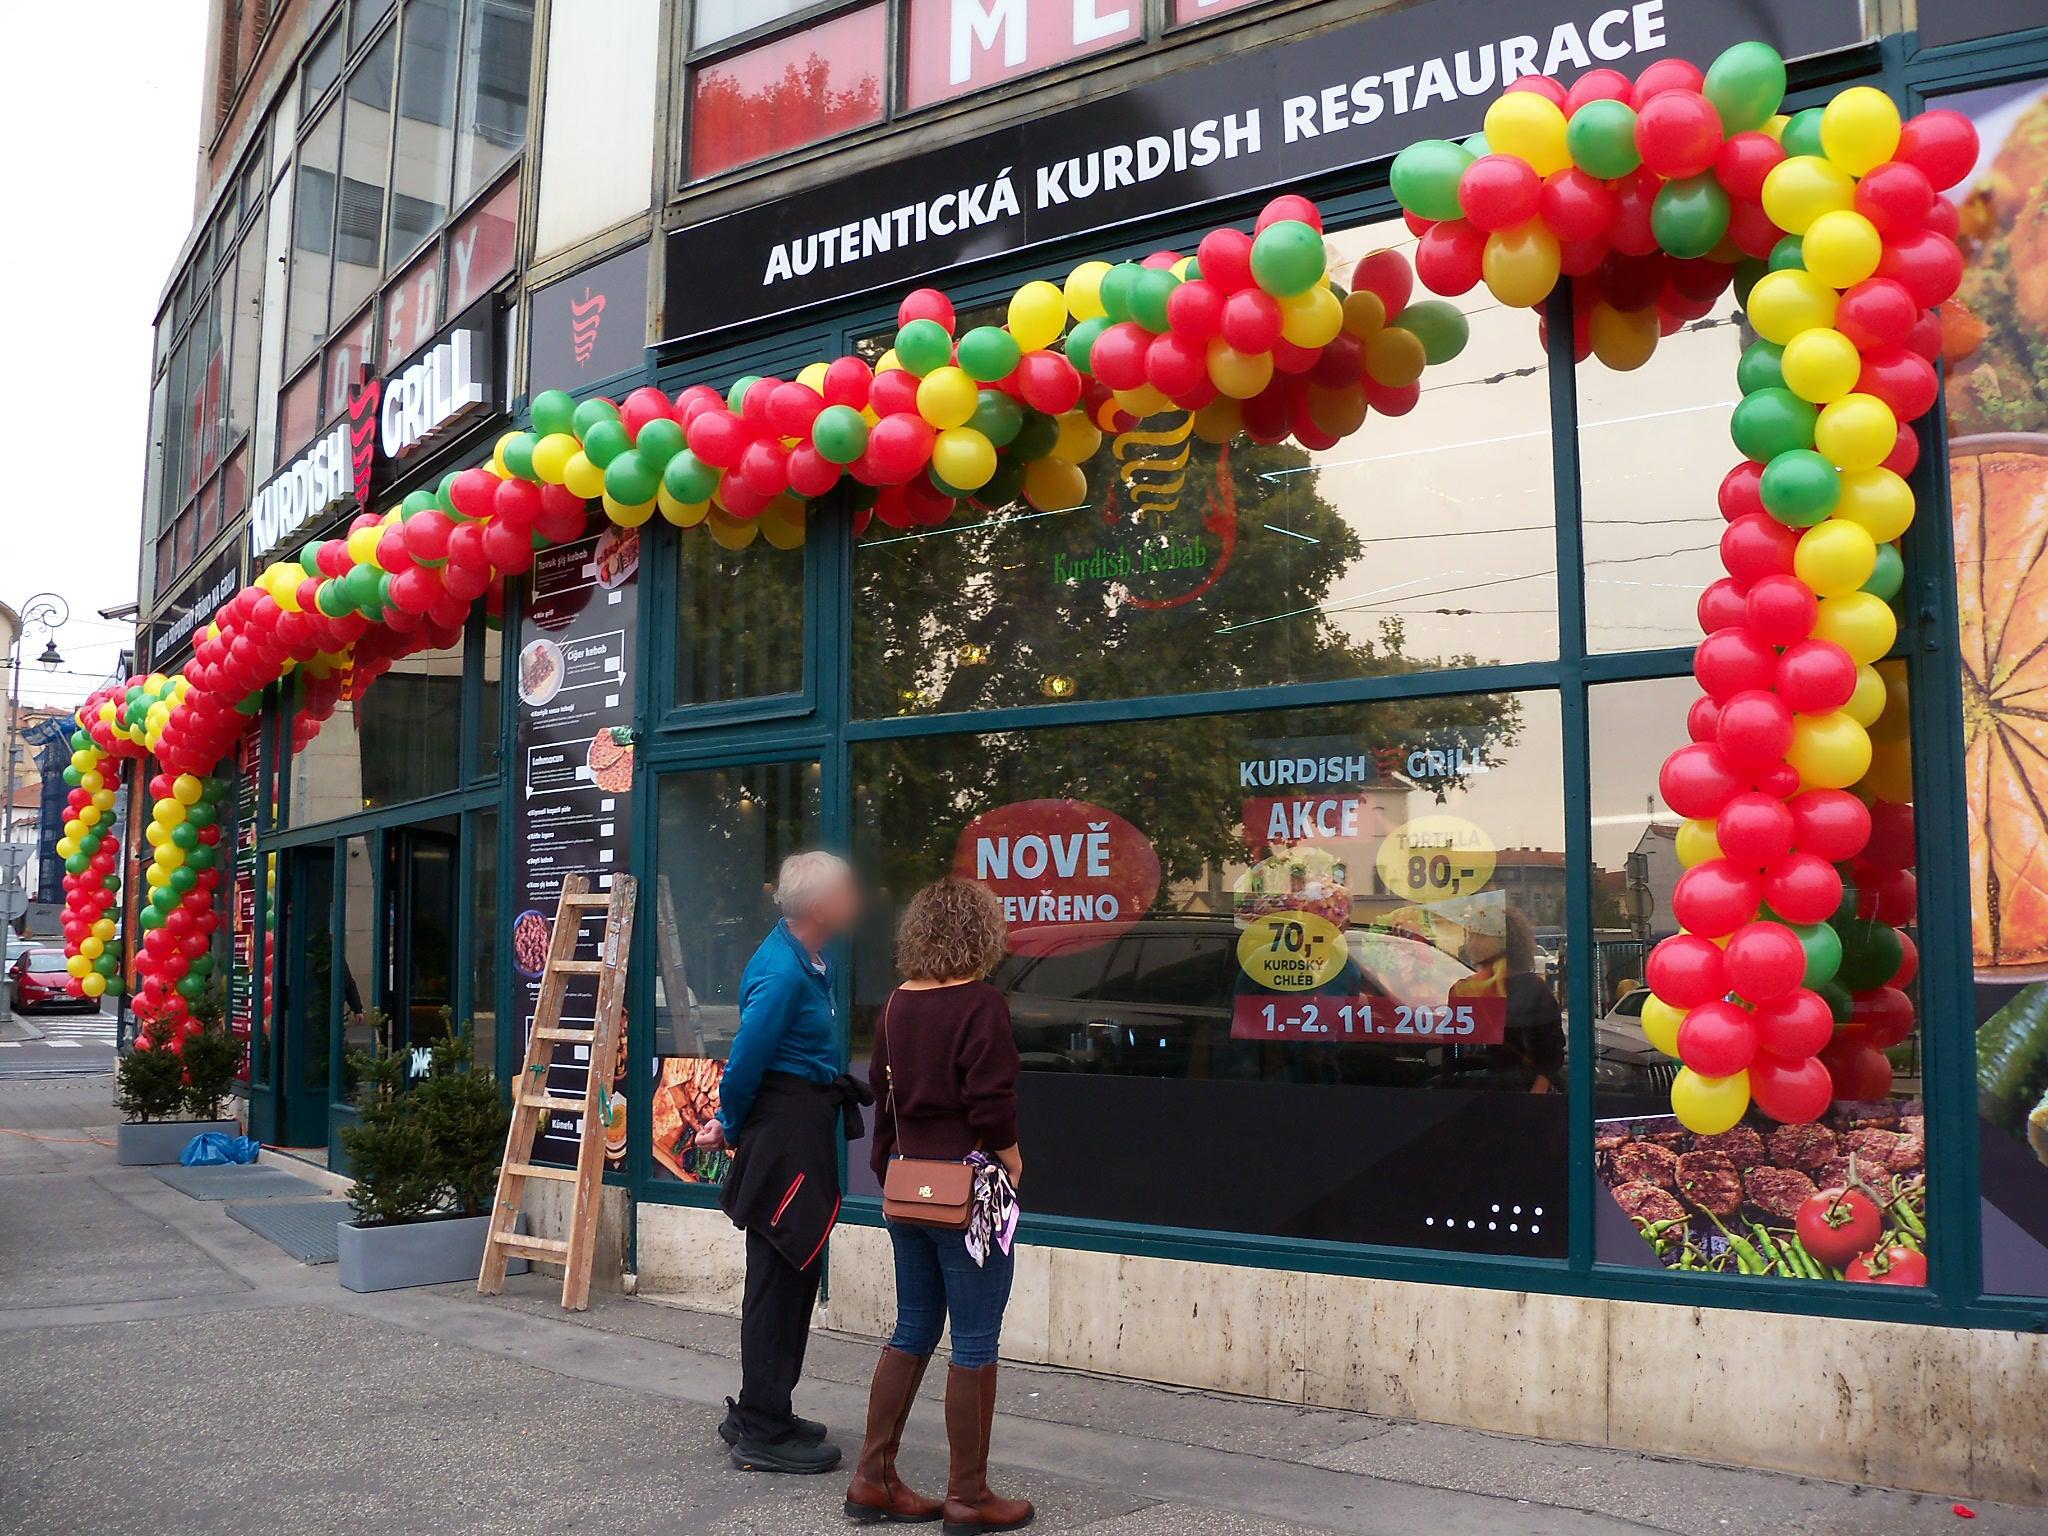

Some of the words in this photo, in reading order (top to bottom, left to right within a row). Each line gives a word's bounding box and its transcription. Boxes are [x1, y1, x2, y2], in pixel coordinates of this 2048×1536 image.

[763, 167, 1021, 286] AUTENTICKÁ
[1036, 108, 1261, 210] KURDISH
[1282, 0, 1667, 144] RESTAURACE
[567, 549, 588, 562] kebab
[1054, 544, 1133, 584] Kurdish
[1142, 535, 1208, 575] Kebab
[586, 643, 607, 657] kebab
[1266, 799, 1359, 839] AKCE
[976, 821, 1110, 880] NOVĚ
[1397, 829, 1482, 850] TORTILLA
[1407, 854, 1475, 895] 80,-
[1268, 922, 1325, 958] 70,-
[1263, 956, 1324, 971] KURDSKÝ
[1273, 972, 1314, 986] CHLÉB
[1337, 1004, 1386, 1034] 11.
[1394, 1005, 1476, 1035] 2025
